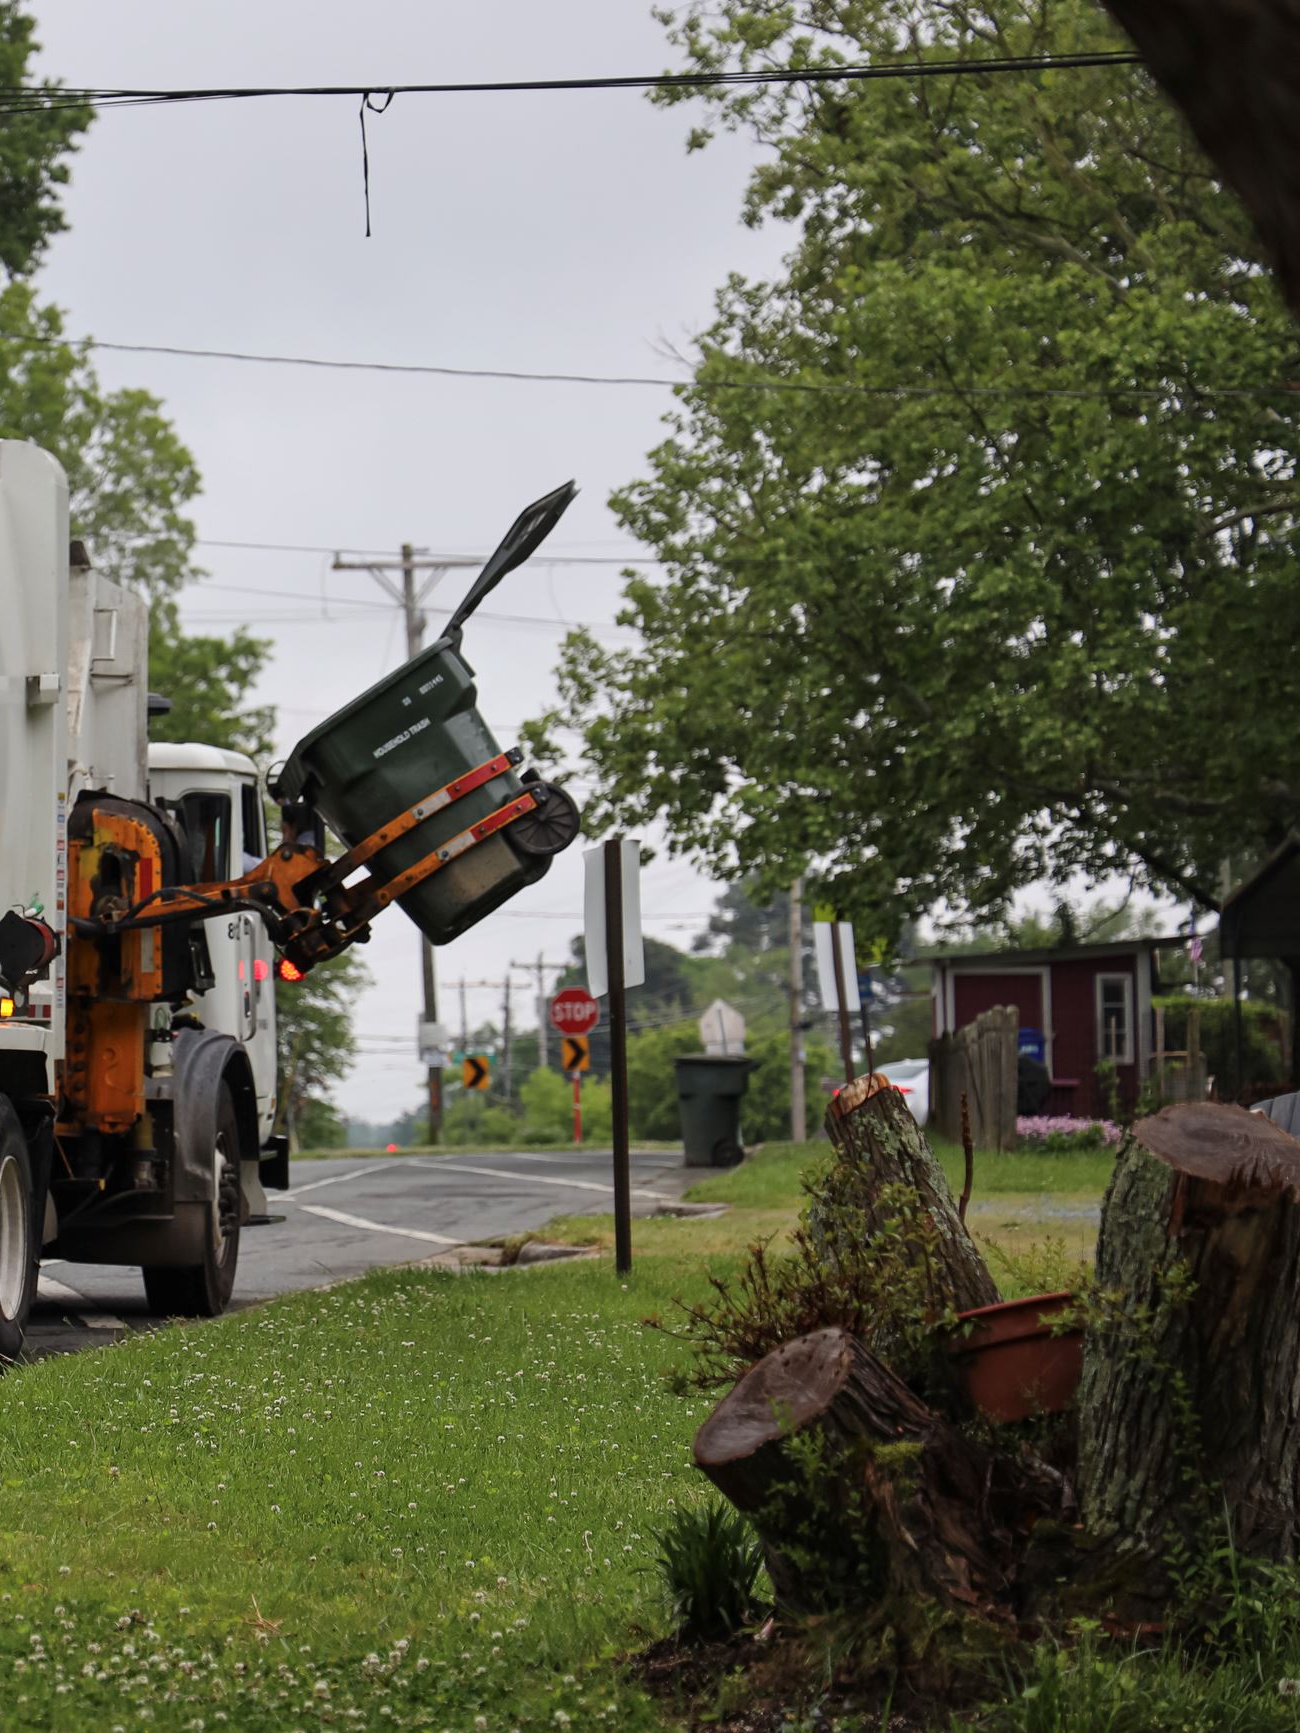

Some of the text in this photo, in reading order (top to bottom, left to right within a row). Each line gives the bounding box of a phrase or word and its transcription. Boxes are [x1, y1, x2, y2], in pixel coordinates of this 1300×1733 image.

[373, 717, 431, 759] HOUSEHOLD TRASH
[554, 1001, 597, 1023] STOP
